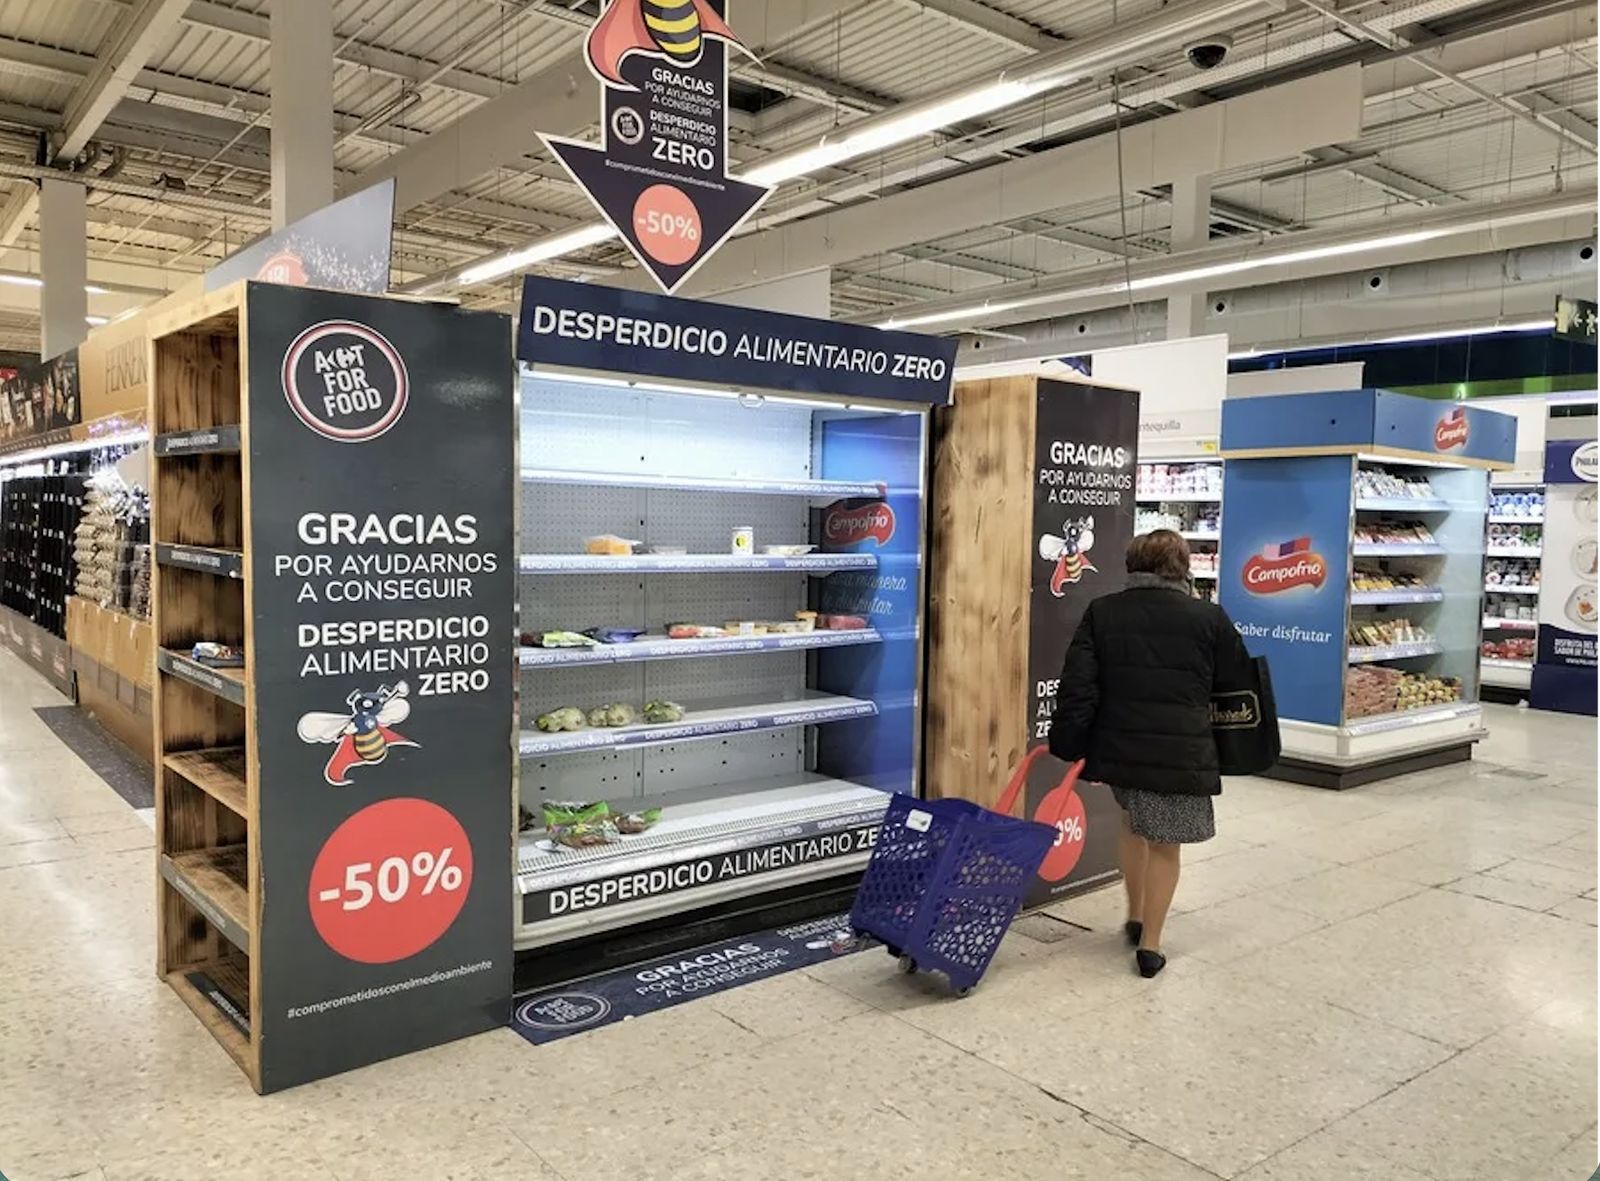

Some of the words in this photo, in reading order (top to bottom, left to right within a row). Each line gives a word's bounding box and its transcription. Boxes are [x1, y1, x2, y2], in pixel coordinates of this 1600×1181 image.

[645, 81, 664, 95] POR
[666, 86, 721, 109] AYUDARNOS
[652, 67, 715, 95] GRACIAS
[652, 94, 660, 103] A
[661, 97, 713, 117] CONSEGUIR
[650, 110, 717, 135] DESPERDICIO
[650, 123, 717, 147] ALIMENTARIO
[652, 136, 715, 170] ZERO
[637, 210, 698, 241] -50%
[532, 305, 728, 356] DESPERDICIO
[733, 334, 887, 375] ALIMENTARIO
[891, 353, 946, 382] ZERO
[324, 367, 369, 394] FOR
[324, 387, 382, 417] FOOD
[1050, 441, 1125, 468] GRACIAS
[1040, 470, 1064, 485] POR
[1066, 471, 1132, 489] AYUDARNOS
[1048, 490, 1057, 503] A
[1061, 489, 1121, 506] CONSEGUIR
[298, 513, 479, 545] GRACIAS
[275, 555, 332, 576] POR
[341, 553, 497, 575] AYUDARNOS
[297, 582, 318, 603] A
[325, 578, 473, 602] CONSEGUIR
[298, 616, 489, 647] DESPERDICIO
[1233, 621, 1270, 636] Saber
[1272, 625, 1332, 643] disfrutar
[300, 642, 489, 677] ALIMENTARIO
[418, 669, 489, 696] ZERO
[319, 848, 462, 911] -50%
[549, 861, 713, 914] DESPERDICIO
[718, 827, 852, 879] ALIMENTARIO
[635, 979, 680, 996] POR
[682, 947, 789, 983] AYUDARNOS
[636, 943, 761, 982] GRACIAS
[287, 959, 492, 1019] #comprometidosconelmedioambiente
[666, 989, 682, 998] A
[682, 958, 786, 993] CONSEGUIR
